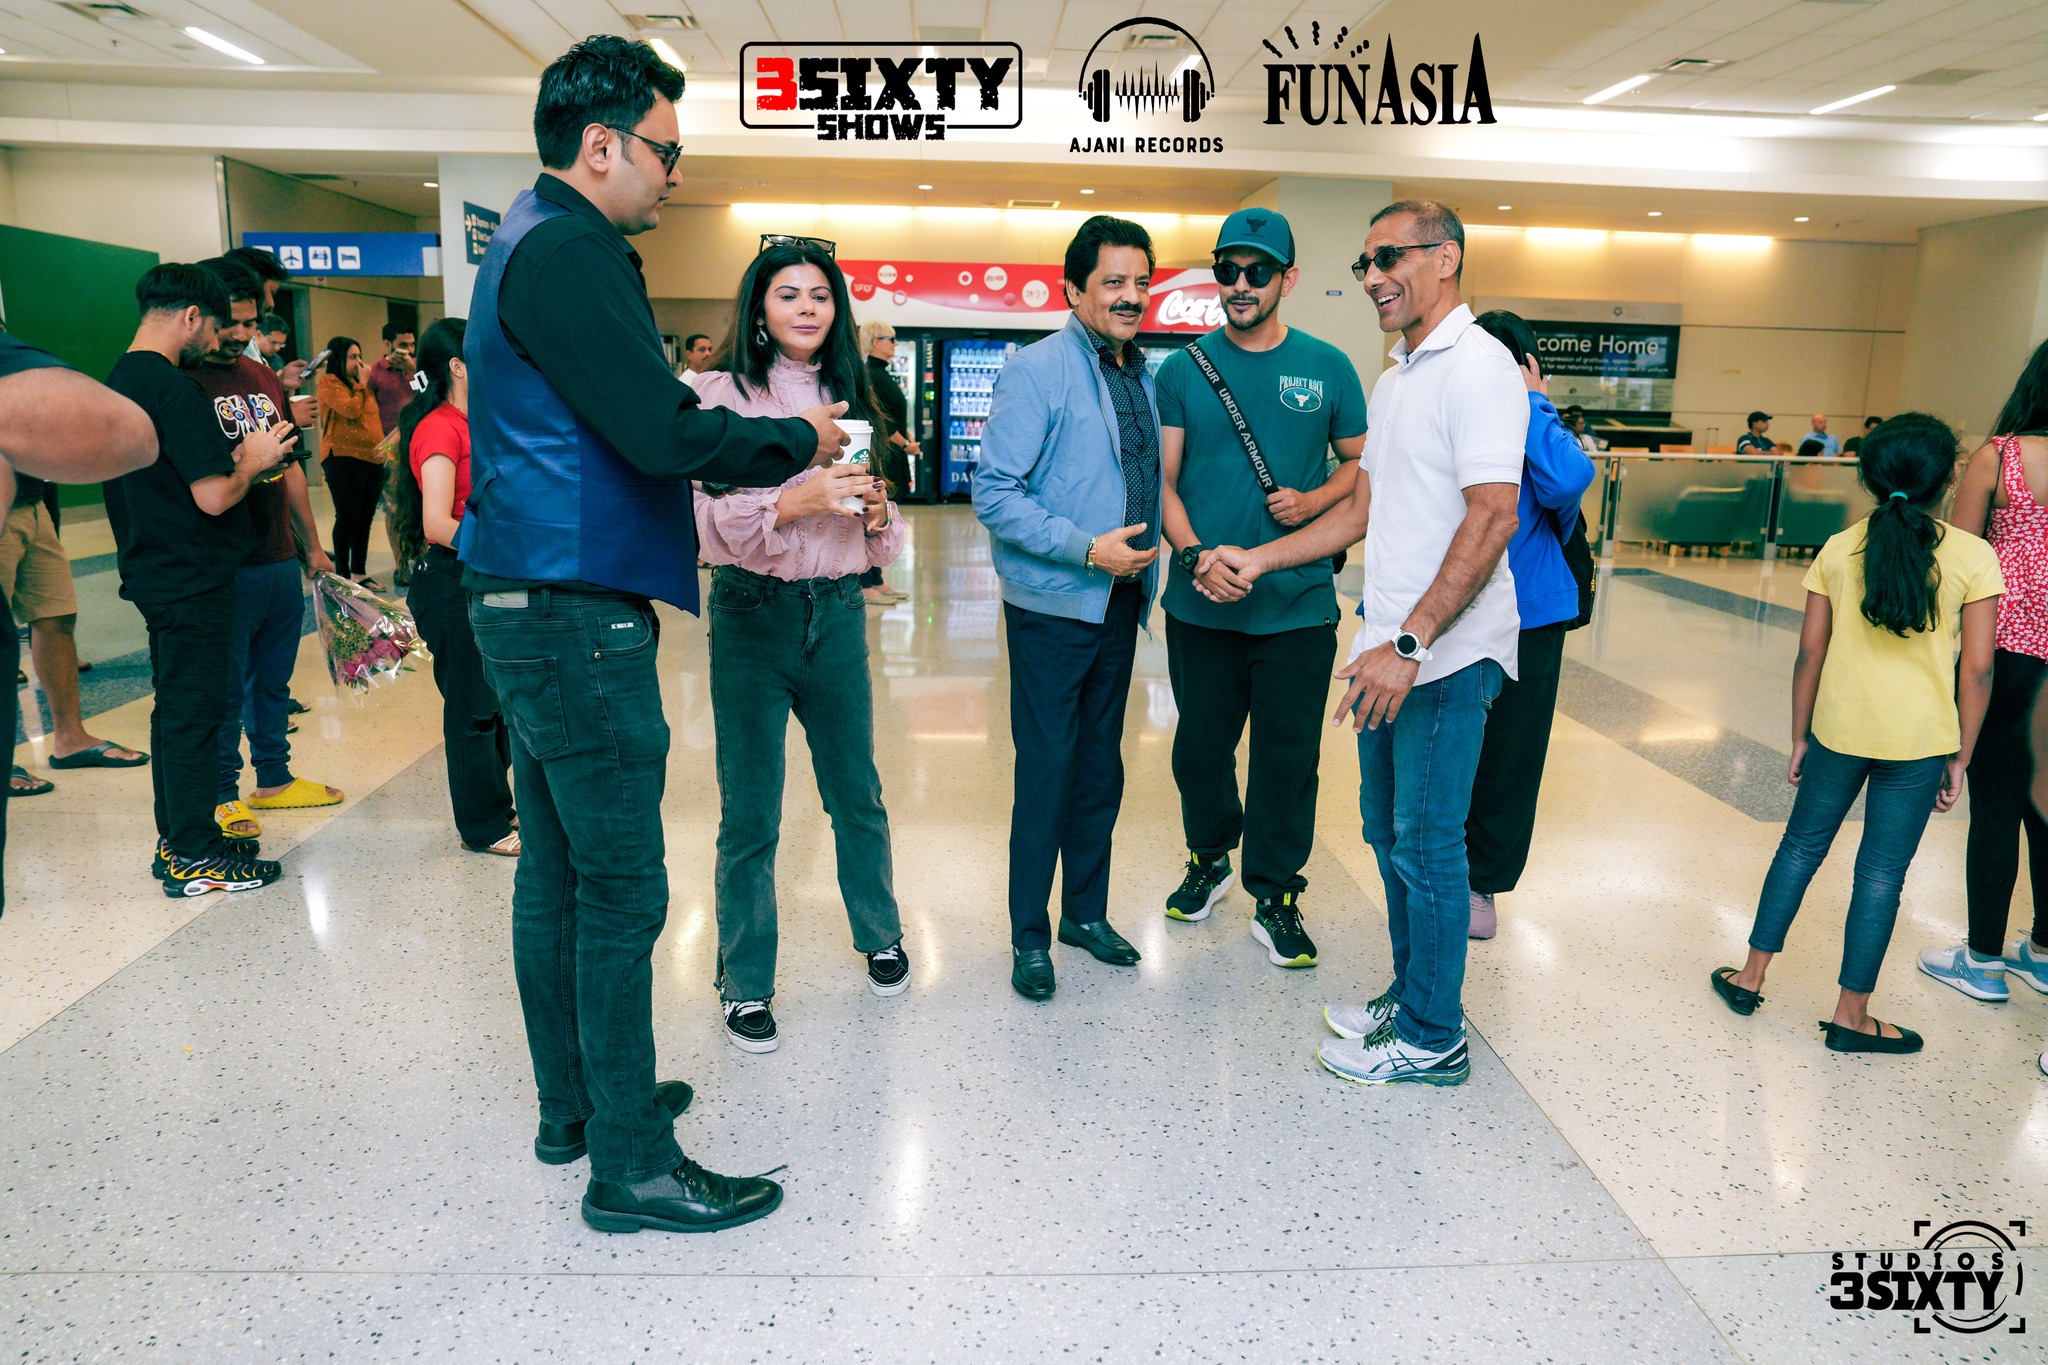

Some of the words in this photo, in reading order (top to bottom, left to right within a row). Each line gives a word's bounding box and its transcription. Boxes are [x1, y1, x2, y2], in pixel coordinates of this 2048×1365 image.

[1537, 338, 1592, 353] come
[1599, 334, 1660, 356] Home
[1279, 375, 1308, 393] PROJECT
[1188, 345, 1220, 384] ARMOUR
[1218, 387, 1247, 431] UNDER
[1240, 431, 1273, 489] ARMOUR
